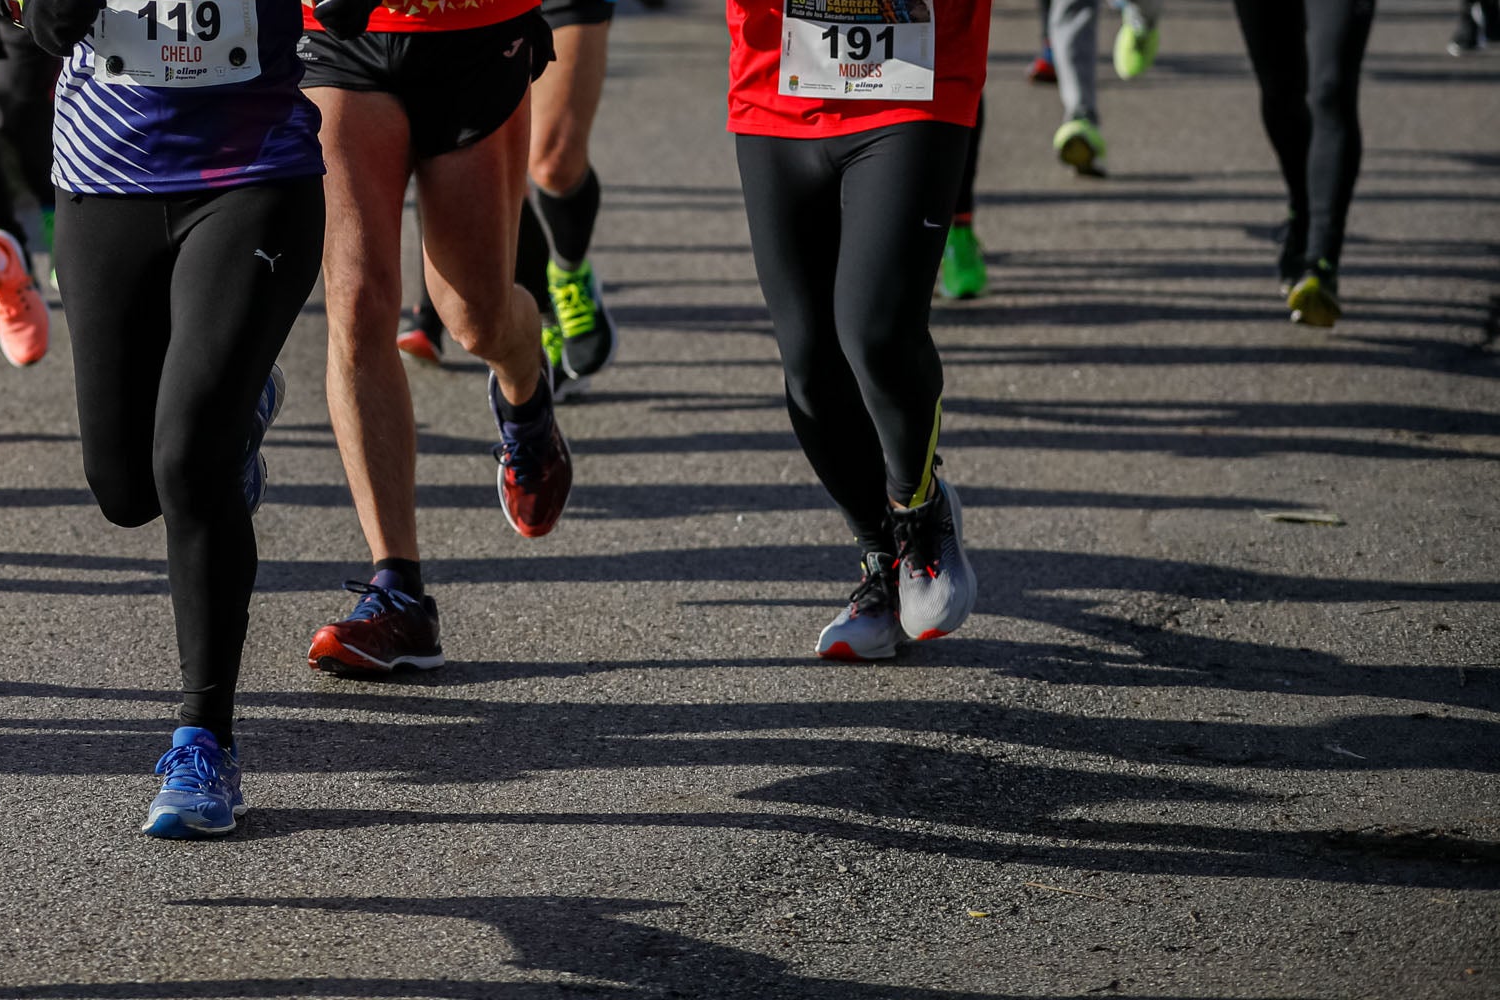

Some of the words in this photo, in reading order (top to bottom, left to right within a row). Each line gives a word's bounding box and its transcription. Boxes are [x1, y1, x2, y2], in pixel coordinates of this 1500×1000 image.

[827, 5, 879, 14] POPULAR
[137, 0, 221, 42] 119
[822, 25, 894, 61] 191
[161, 45, 202, 63] CHELO
[176, 67, 208, 76] olimpo
[838, 61, 883, 78] MOISÉS
[855, 81, 884, 89] olimpo
